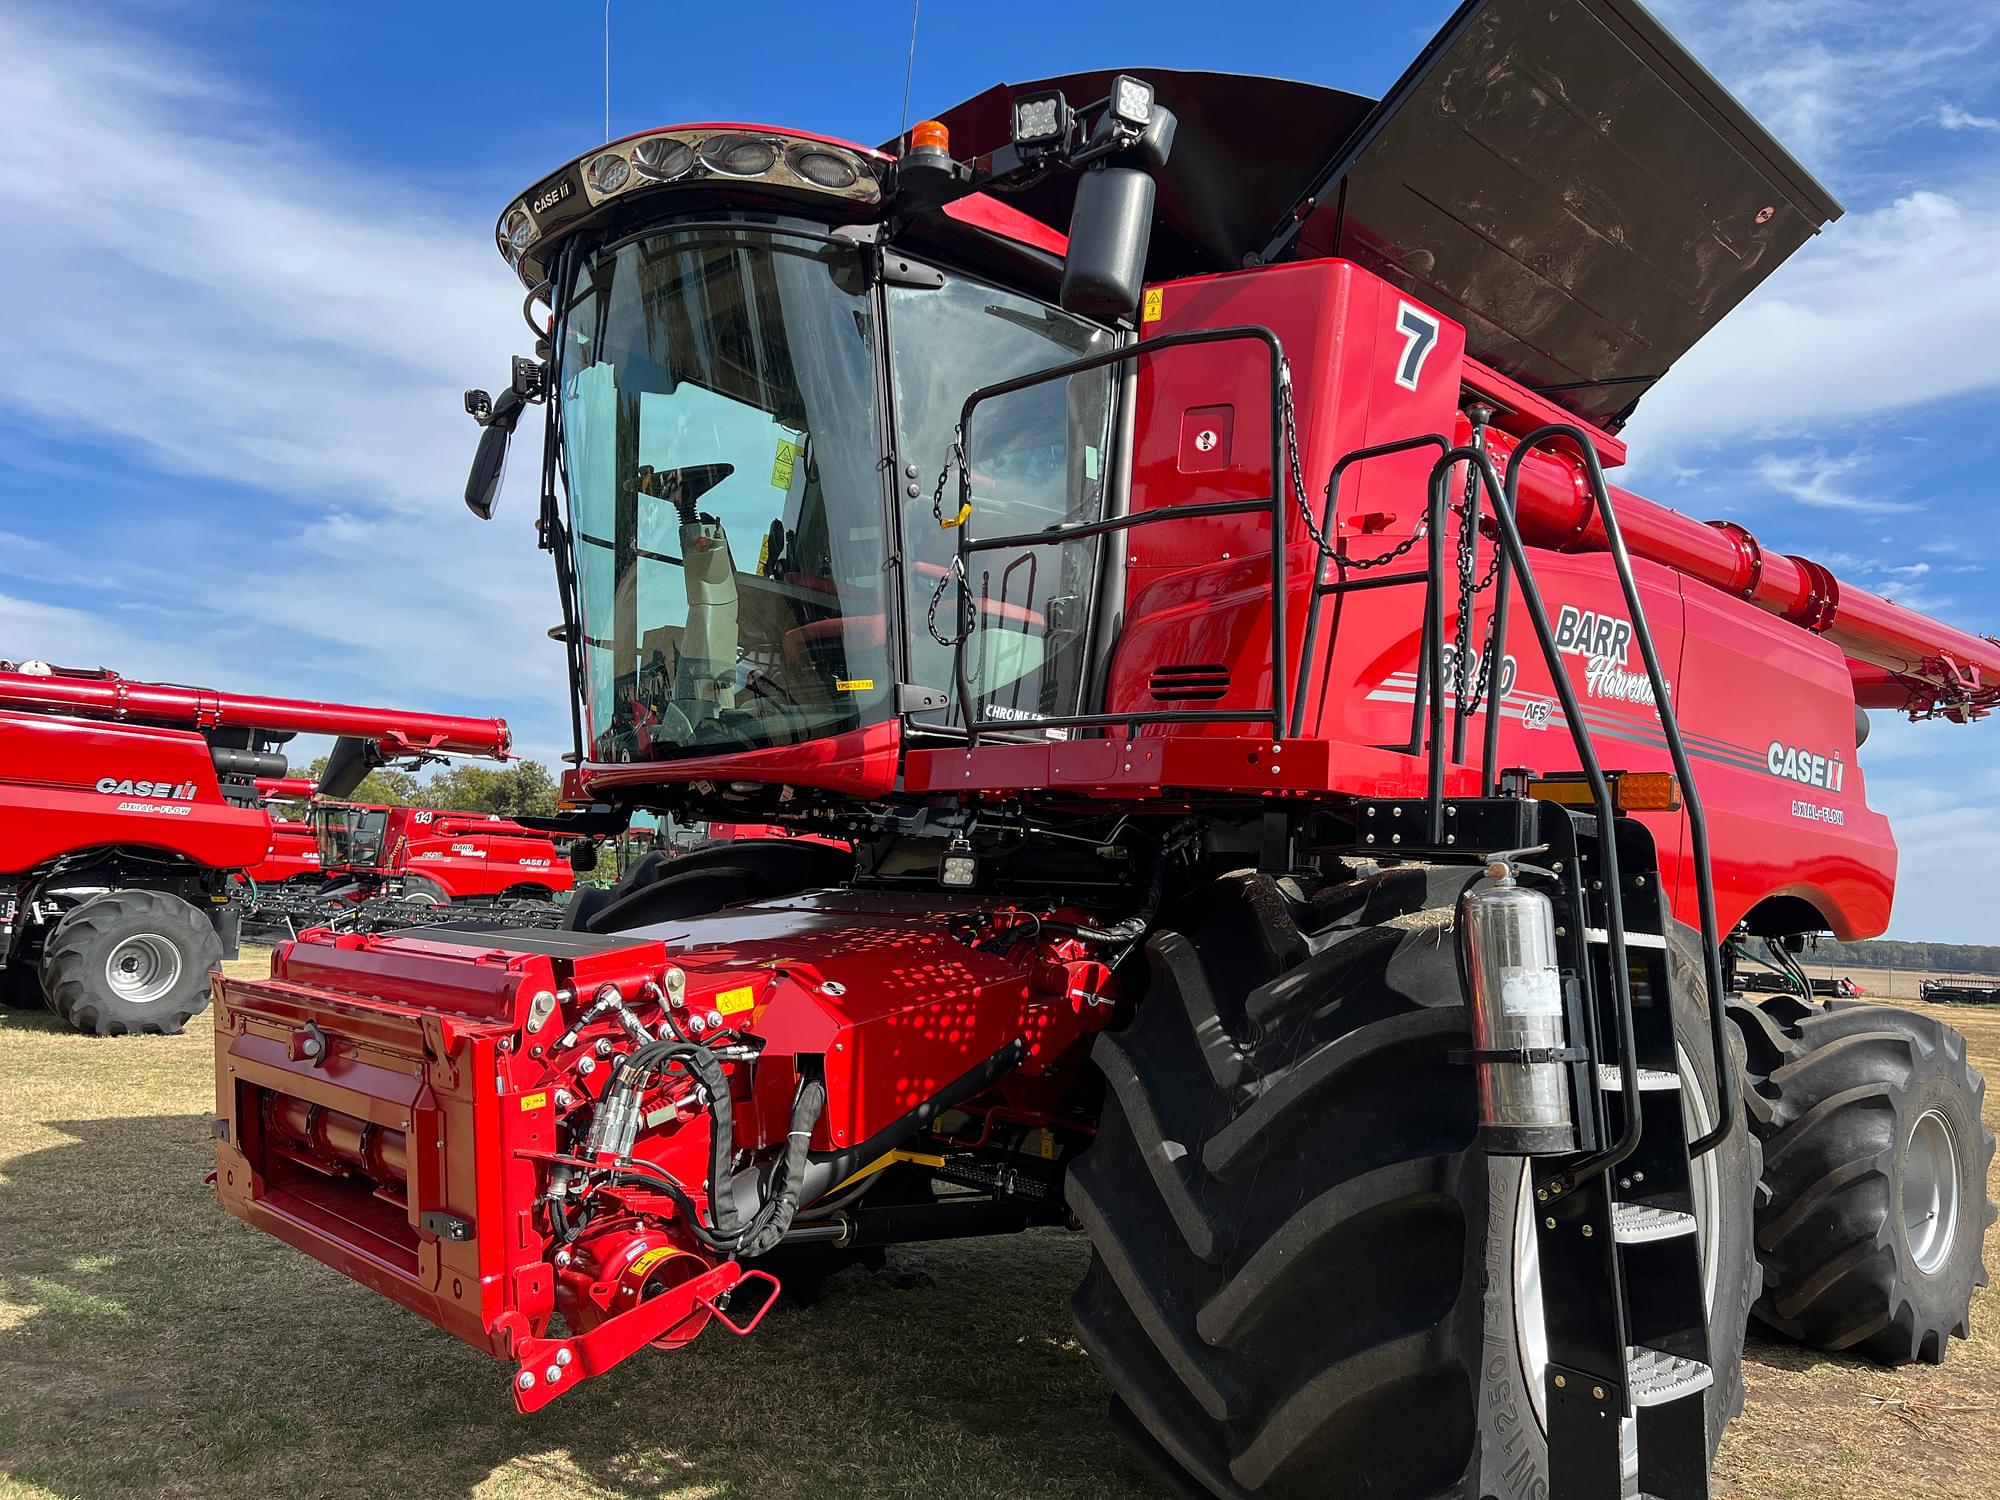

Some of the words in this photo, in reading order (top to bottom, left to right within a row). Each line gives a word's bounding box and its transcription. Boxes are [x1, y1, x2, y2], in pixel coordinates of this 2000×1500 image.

[534, 189, 560, 214] CASE
[1394, 299, 1440, 392] 7
[1555, 605, 1631, 666] BARR
[1585, 653, 1671, 720] Harvesti
[985, 704, 1030, 720] CHROME
[1523, 702, 1548, 722] AFS
[1767, 741, 1826, 788] CASE
[96, 777, 172, 798] CASE
[118, 802, 191, 815] AXIAL-FLOW
[415, 811, 432, 824] 14
[1791, 800, 1844, 825] AXIAL-FLOW
